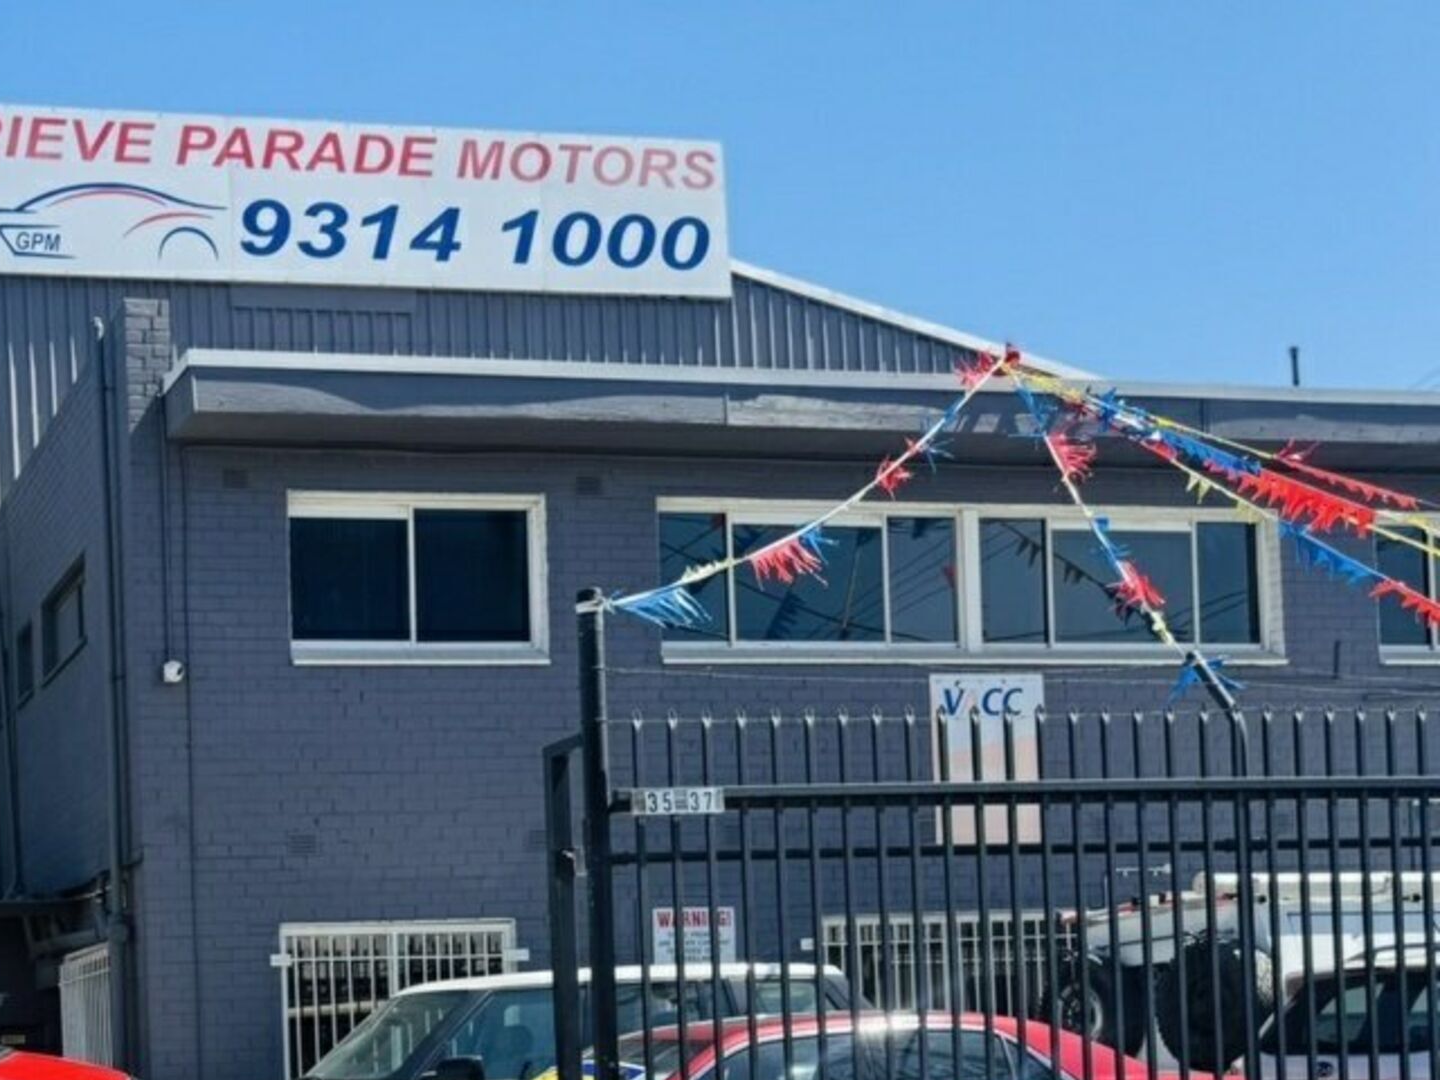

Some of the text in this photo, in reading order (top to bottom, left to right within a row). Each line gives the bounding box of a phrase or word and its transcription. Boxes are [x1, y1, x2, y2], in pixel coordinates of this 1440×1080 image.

[176, 124, 437, 178] PARADE
[456, 139, 717, 190] MOTORS
[15, 230, 62, 253] GPM
[240, 198, 711, 271] 9314 1000
[656, 909, 733, 929] WRNIG!
